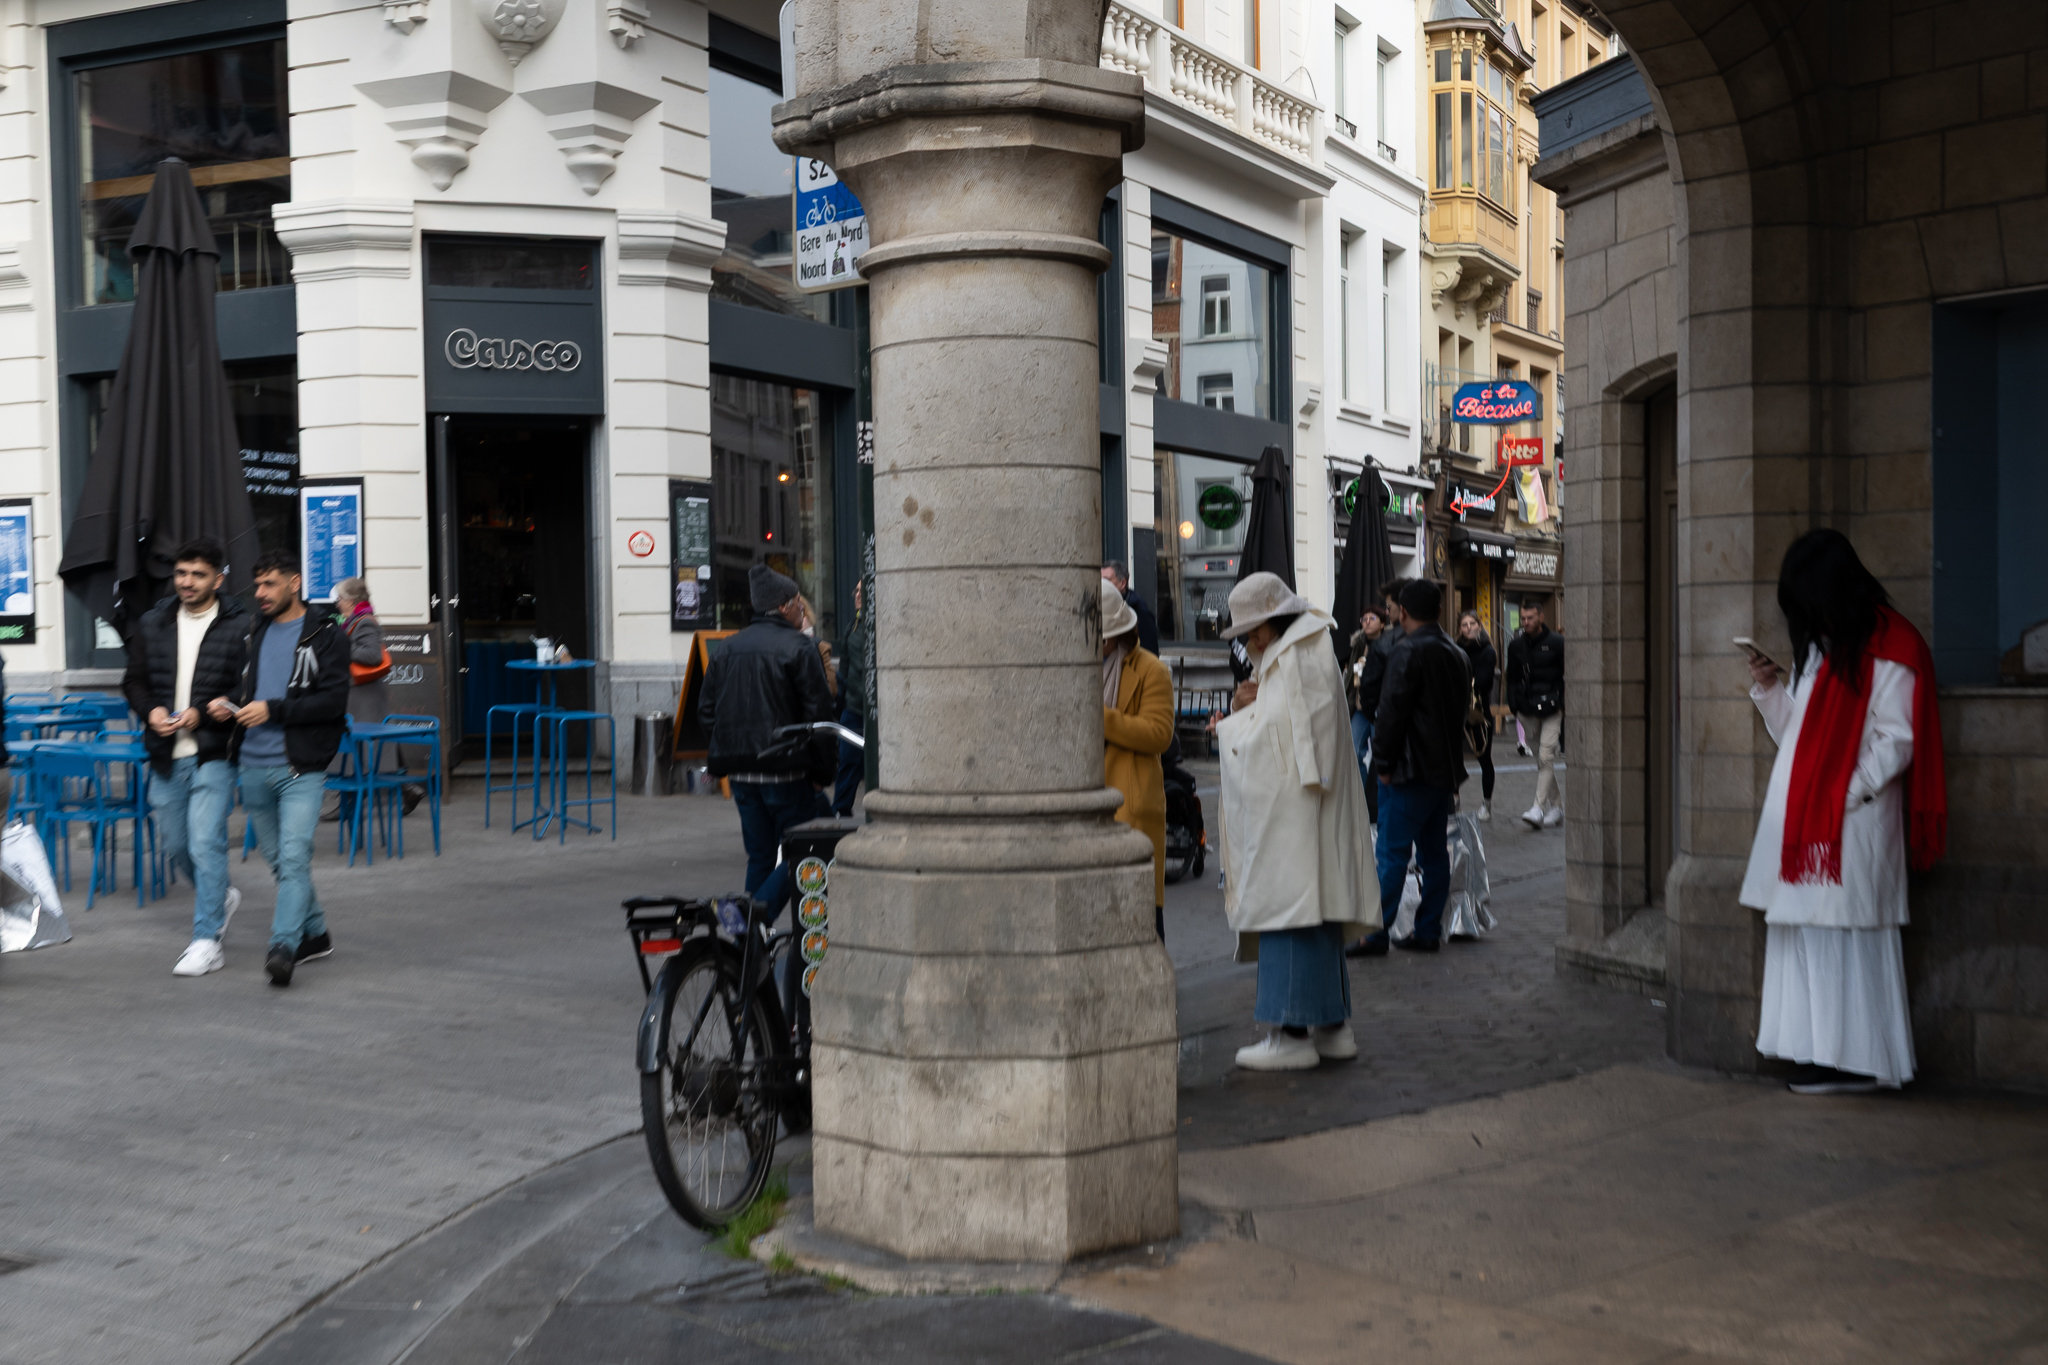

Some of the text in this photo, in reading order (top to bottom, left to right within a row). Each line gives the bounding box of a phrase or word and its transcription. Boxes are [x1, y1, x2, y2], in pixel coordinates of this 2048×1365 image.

[800, 234, 821, 252] Gare
[841, 223, 863, 242] Nord
[444, 327, 582, 372] Casco
